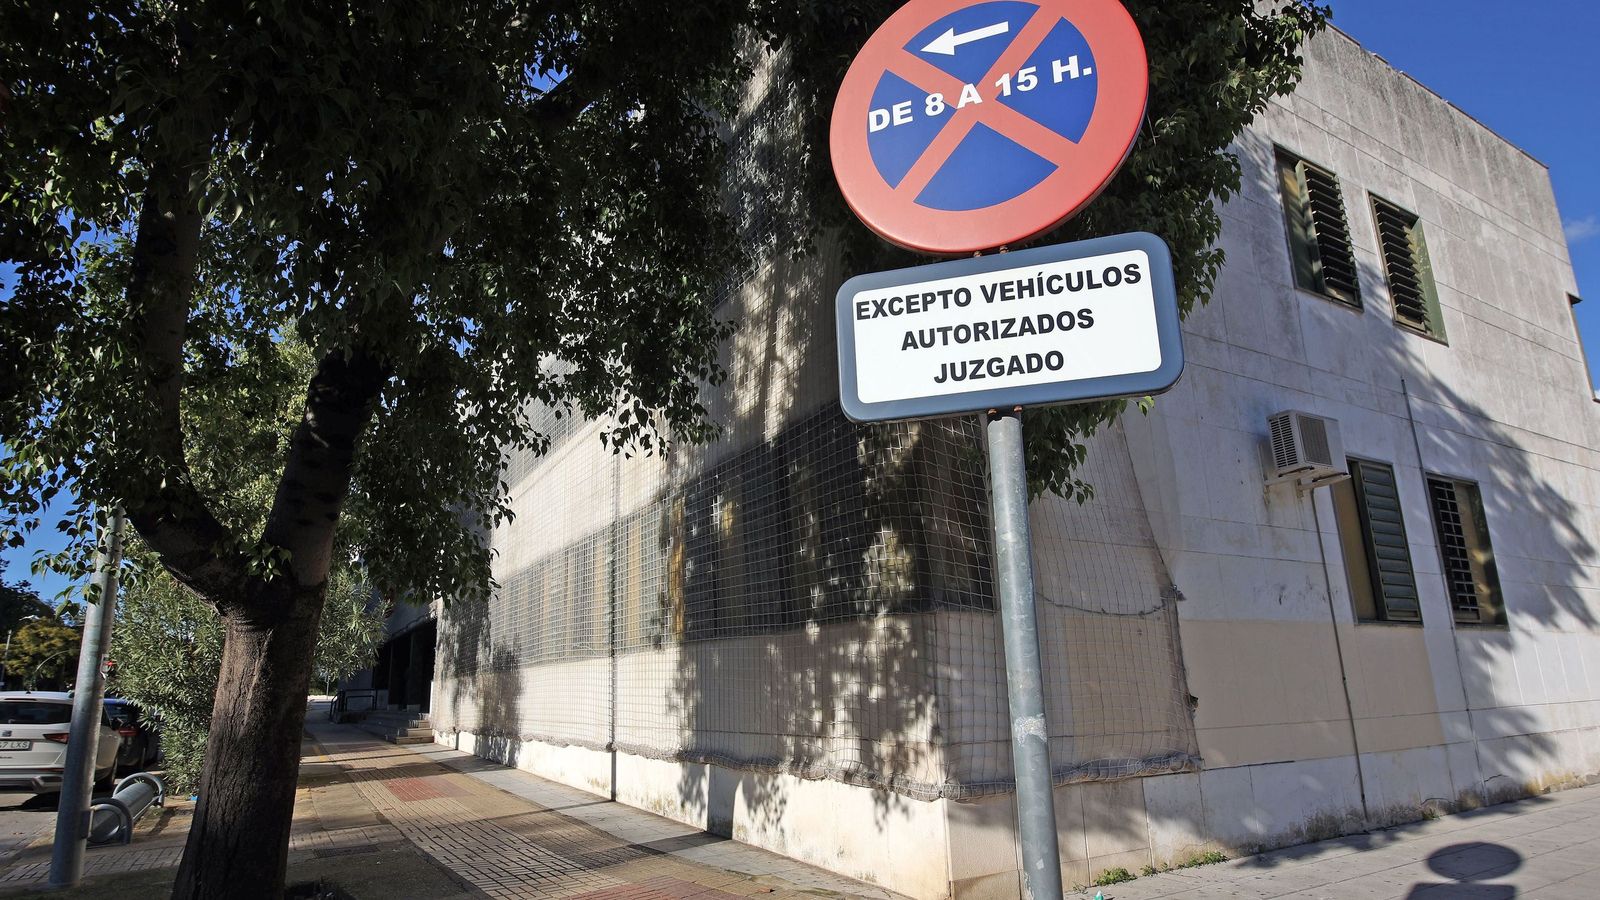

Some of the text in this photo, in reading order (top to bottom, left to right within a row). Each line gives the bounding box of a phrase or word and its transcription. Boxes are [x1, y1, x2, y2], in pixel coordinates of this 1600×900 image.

[868, 55, 1092, 133] DE 8 A 15 H.
[856, 263, 1142, 321] EXCEPTO VEHÍCULOS
[901, 308, 1095, 351] AUTORIZADOS
[933, 350, 1064, 384] JUZGADO
